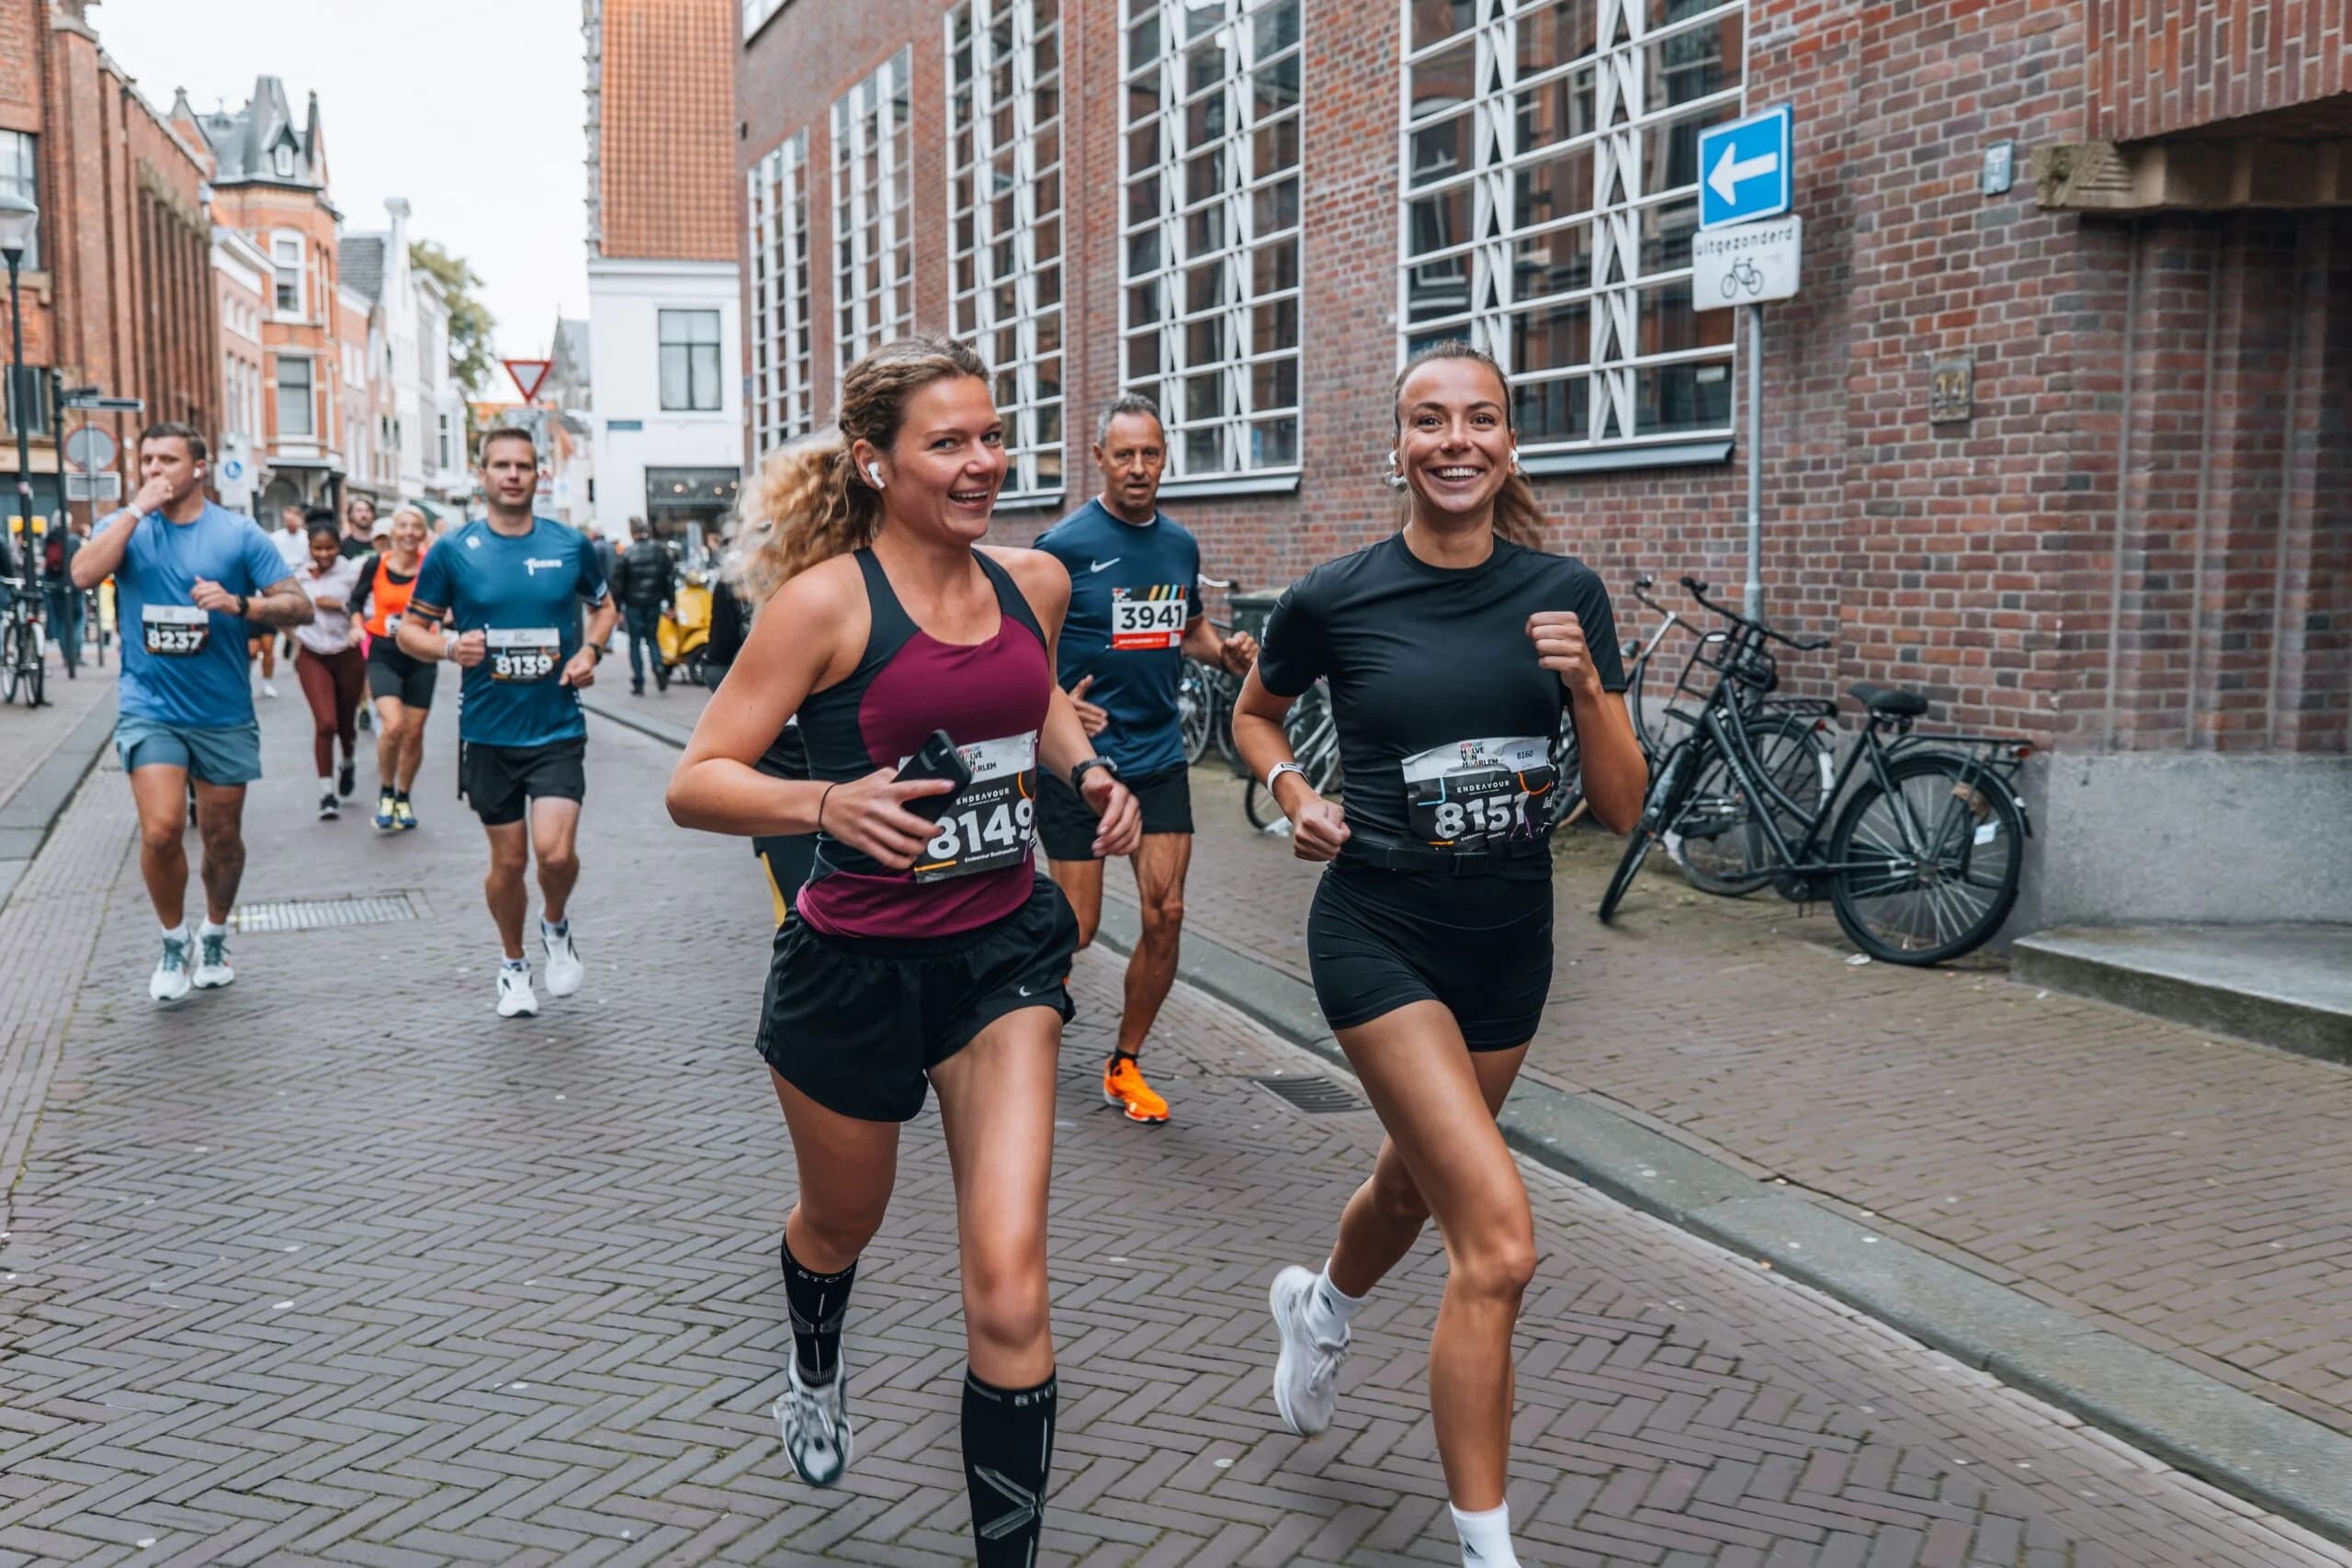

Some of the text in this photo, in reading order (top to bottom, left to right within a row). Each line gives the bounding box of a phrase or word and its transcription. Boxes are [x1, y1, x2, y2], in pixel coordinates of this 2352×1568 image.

[1696, 226, 1792, 256] uitgezonderd
[1121, 604, 1182, 630] 3941
[147, 630, 204, 649] 8237
[496, 654, 553, 675] 8139
[956, 787, 1010, 806] ENDEAVOUR
[1456, 780, 1510, 794] ENDEAVOUR
[1434, 791, 1530, 839] 8157
[927, 797, 1035, 860] 8149
